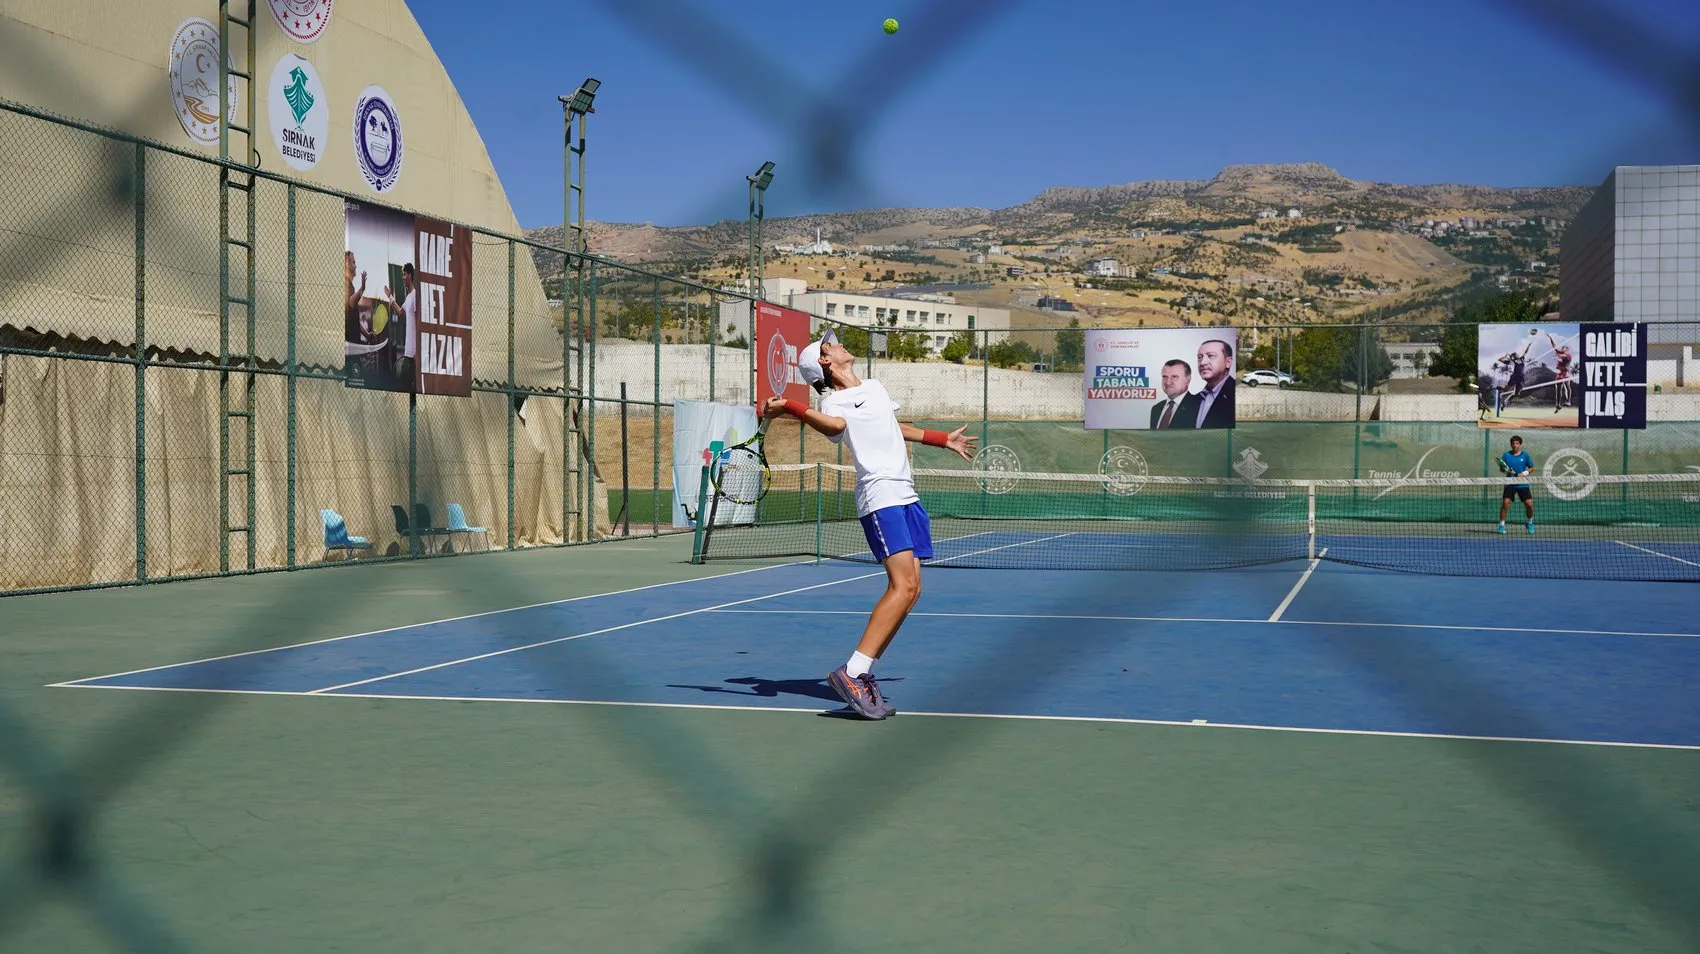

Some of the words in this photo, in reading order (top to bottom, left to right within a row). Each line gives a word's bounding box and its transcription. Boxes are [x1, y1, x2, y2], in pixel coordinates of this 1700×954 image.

[1585, 329, 1638, 358] GALİBİ
[1100, 366, 1140, 377] SPORU
[1584, 362, 1625, 387] YETE
[1096, 378, 1144, 388] TABANA
[1090, 389, 1156, 398] YAYIYORUZ
[1584, 391, 1626, 420] ULAŞ
[1368, 470, 1402, 478] Tennis
[1422, 469, 1460, 479] Europe
